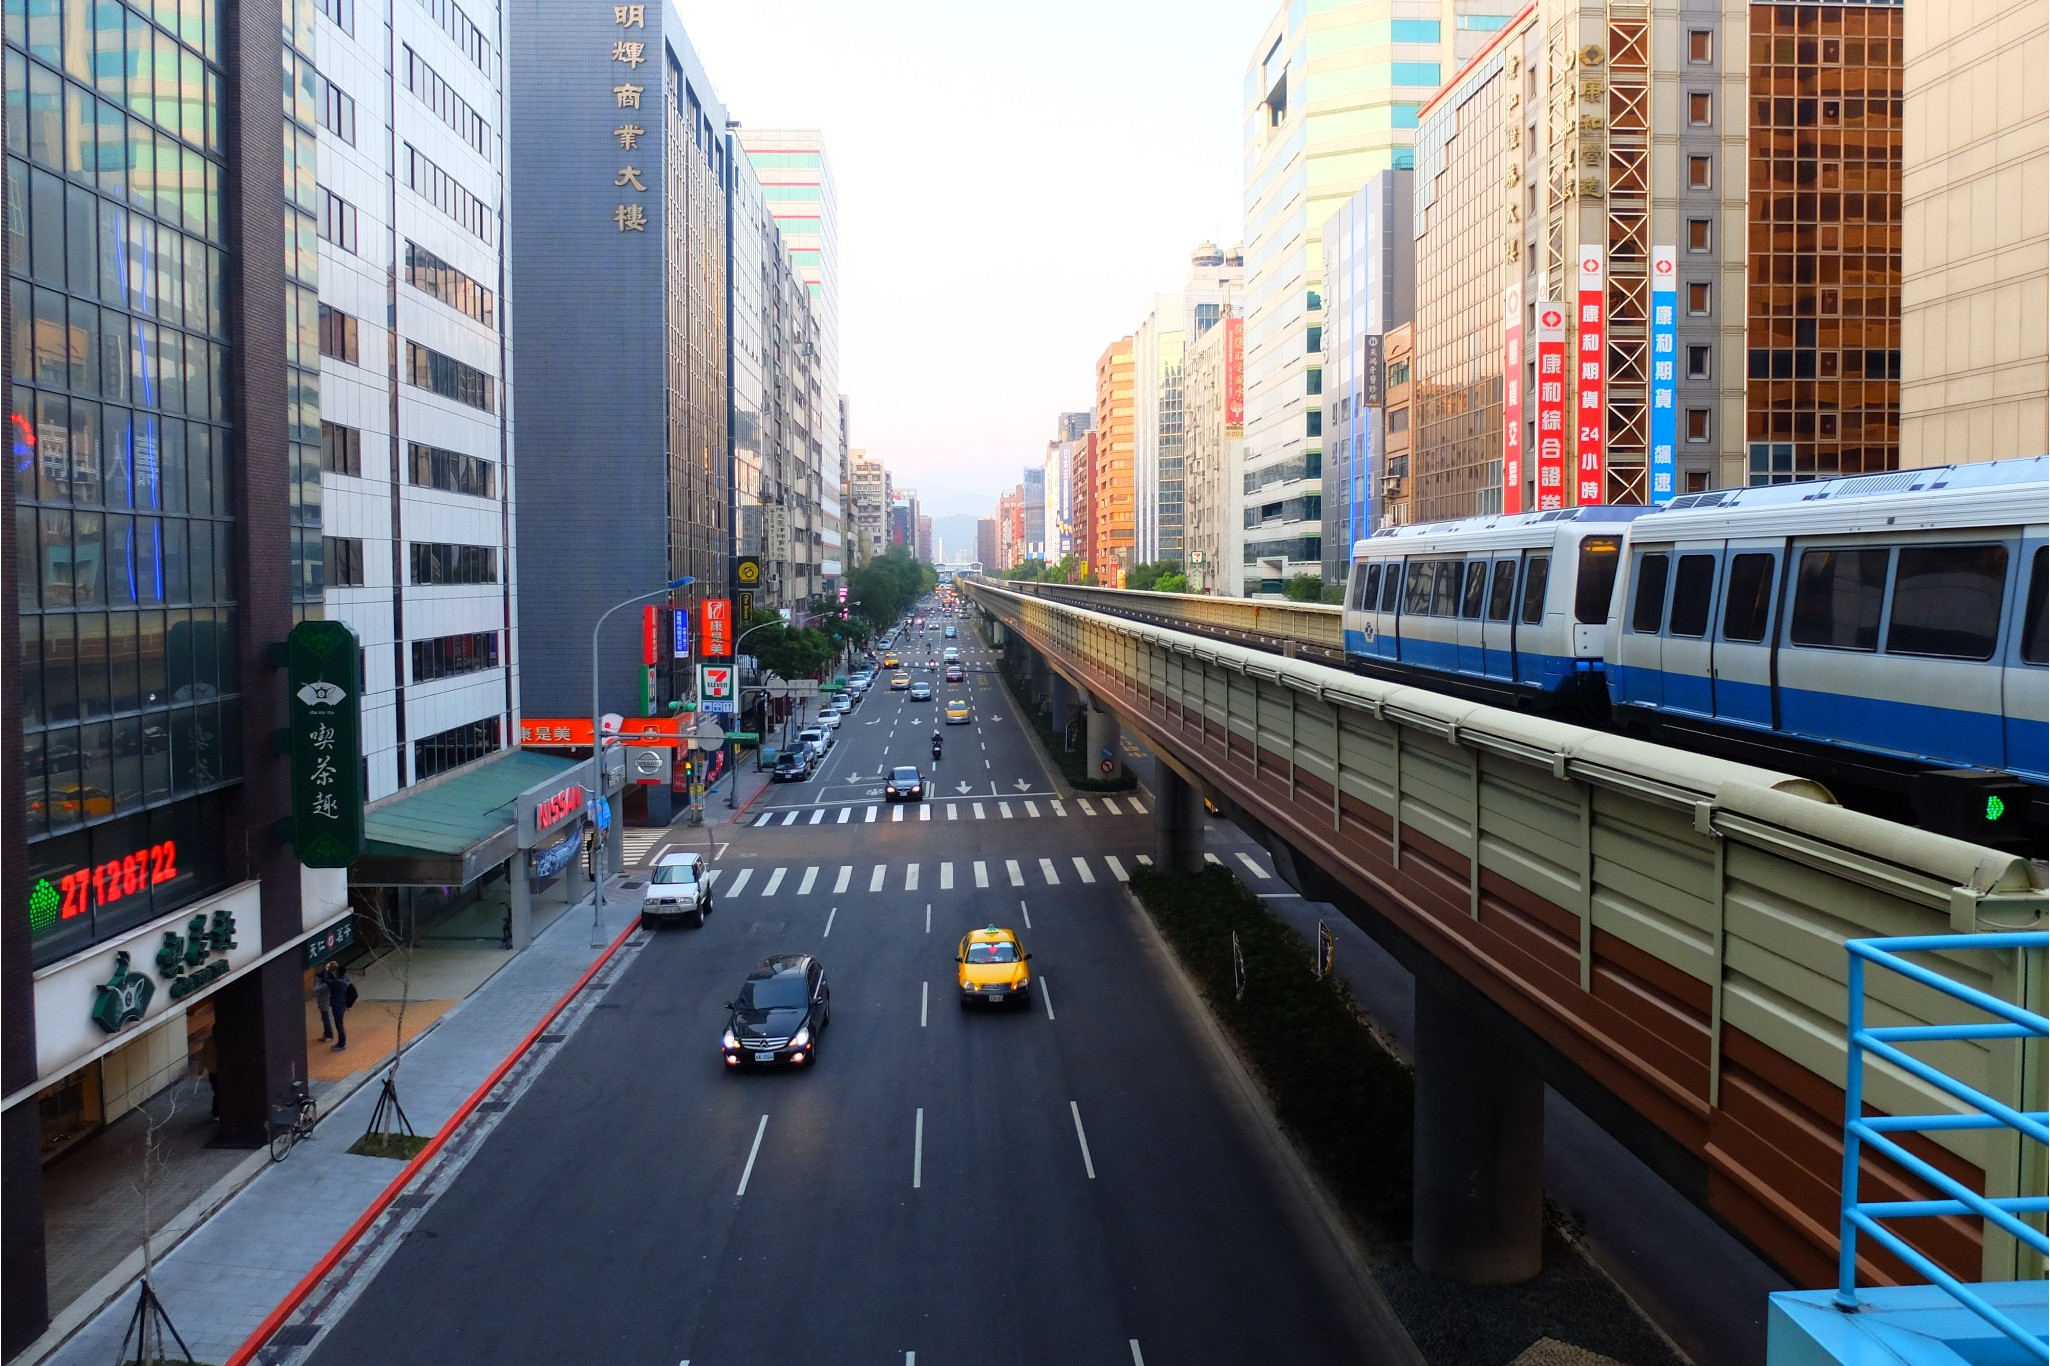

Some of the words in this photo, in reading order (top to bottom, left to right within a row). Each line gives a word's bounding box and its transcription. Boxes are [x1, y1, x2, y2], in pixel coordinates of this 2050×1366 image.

[612, 4, 648, 233] 明輝商業大樓
[1579, 80, 1605, 199] 康和營造
[1582, 304, 1600, 409] 康和期貨
[1654, 305, 1674, 408] 康和期貨
[1507, 338, 1519, 488] 期貨交易
[1541, 353, 1562, 511] 康和綜合證券
[1581, 426, 1600, 500] 24小時
[711, 620, 724, 655] 康是美
[309, 722, 339, 820] 喫茶趣
[521, 727, 572, 742] 康是美
[537, 787, 583, 832] NISSAN
[61, 840, 178, 920] 27128722
